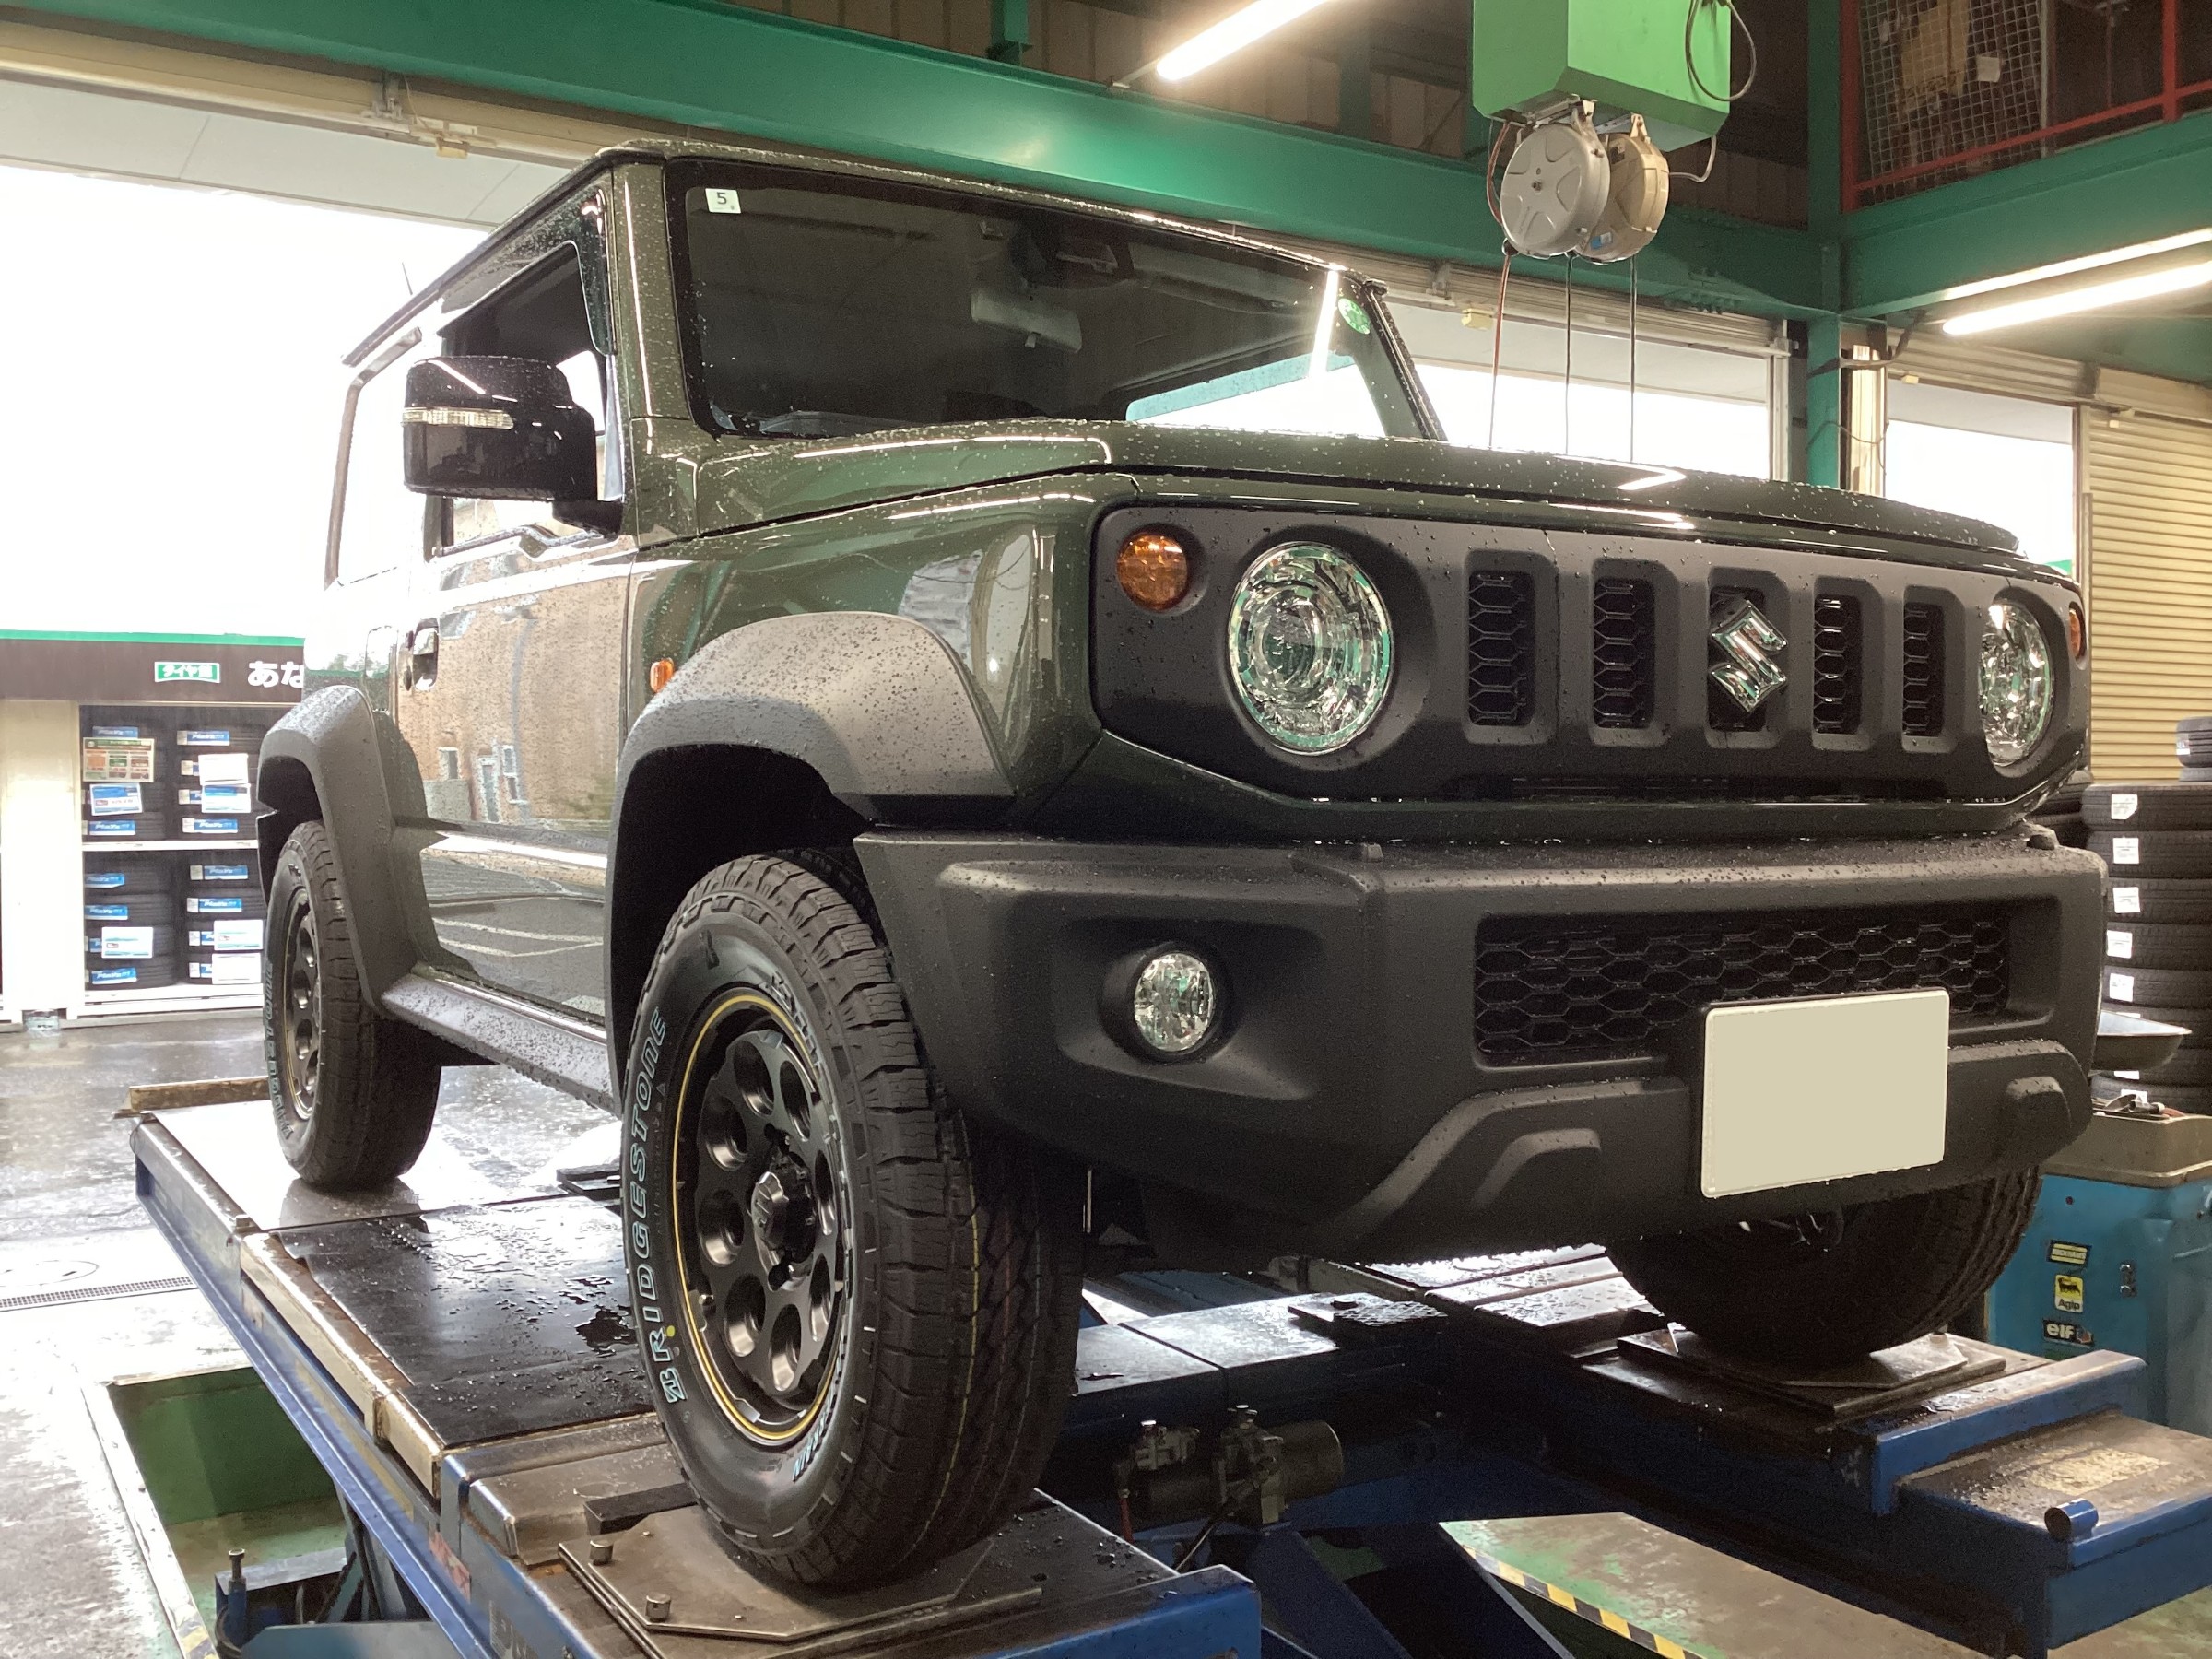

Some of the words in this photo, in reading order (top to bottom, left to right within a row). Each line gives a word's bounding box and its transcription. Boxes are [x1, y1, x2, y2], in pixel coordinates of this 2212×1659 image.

[715, 191, 728, 205] 5
[628, 1005, 689, 1406] BRIDGESTONE
[2057, 1298, 2081, 1311] Agip
[2046, 1323, 2075, 1339] elf
